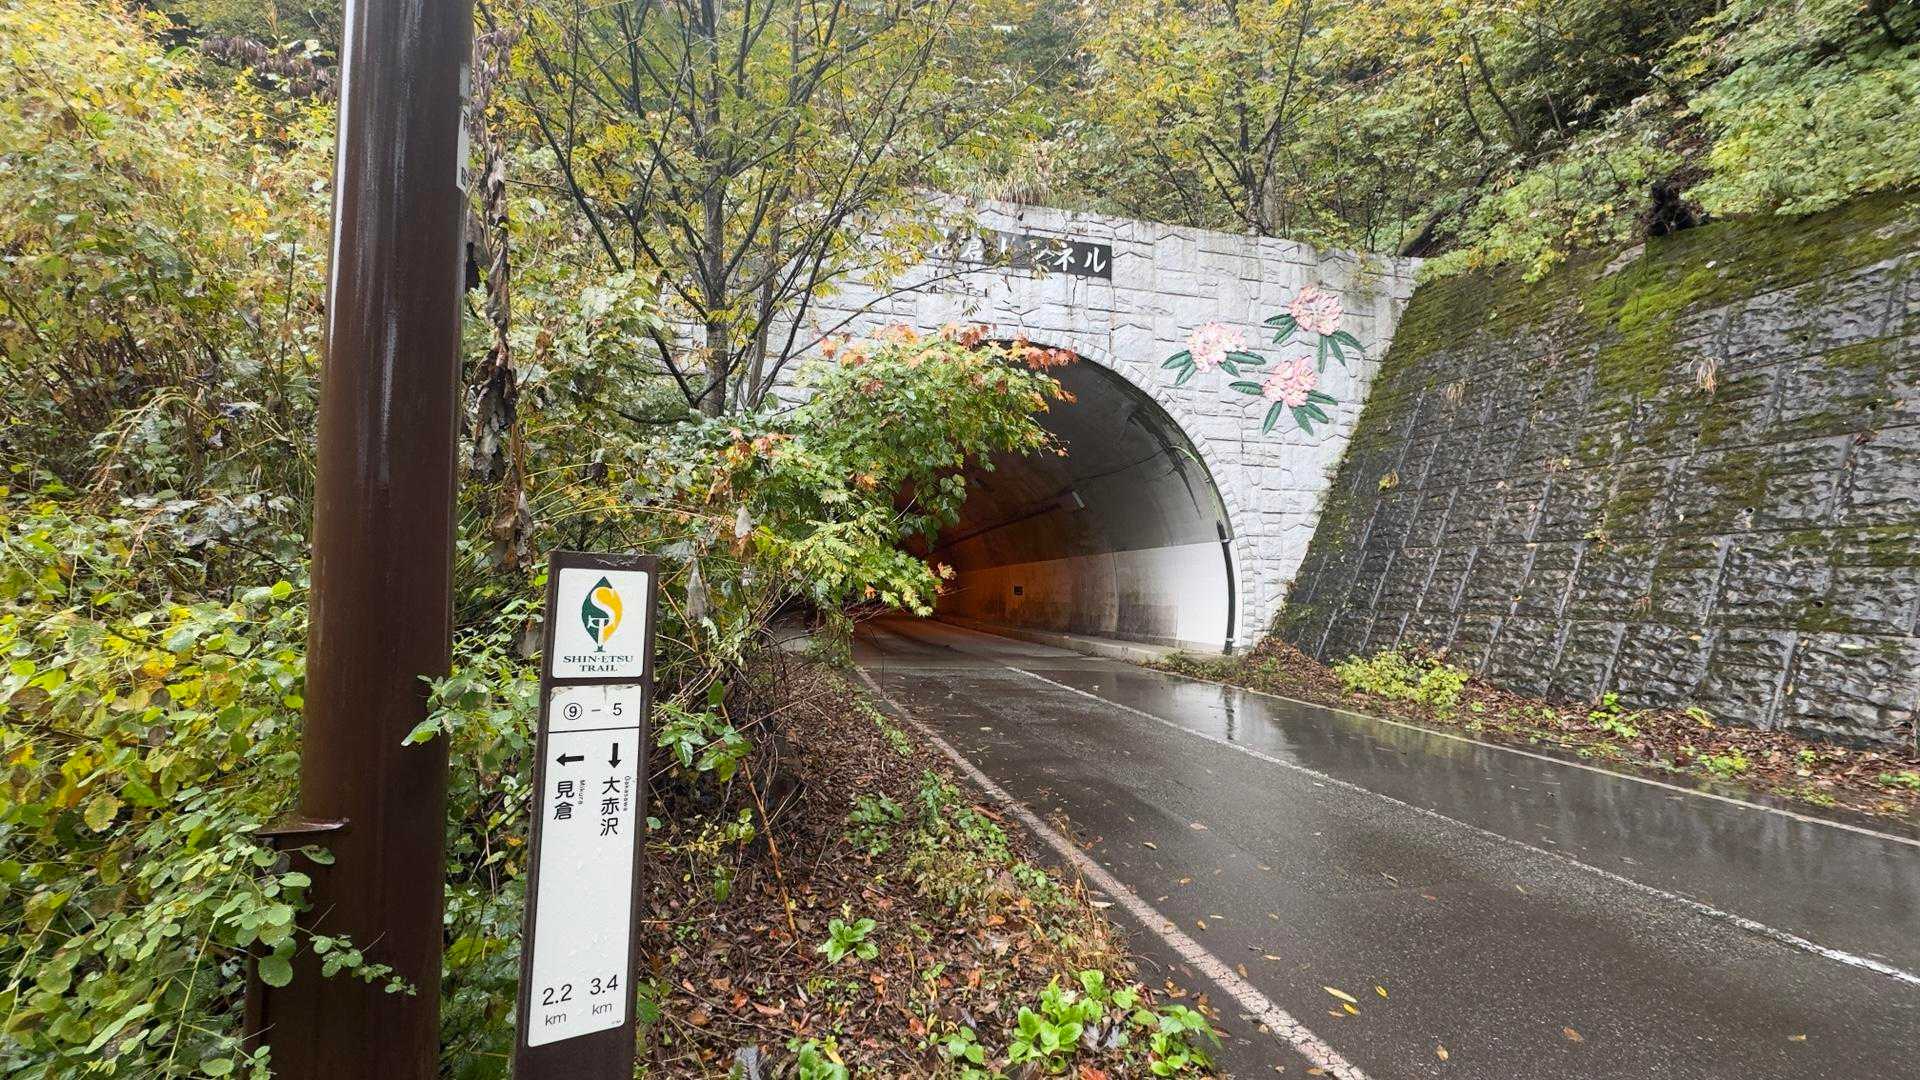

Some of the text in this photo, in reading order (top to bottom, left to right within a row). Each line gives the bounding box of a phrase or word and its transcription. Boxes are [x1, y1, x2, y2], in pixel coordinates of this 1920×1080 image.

[579, 664, 619, 672] TRAIL
[612, 702, 623, 716] 5
[553, 780, 575, 820] 見倉
[600, 776, 621, 836] 大赤沢
[590, 974, 618, 996] 3.4
[542, 984, 573, 1006] 2.2
[592, 1003, 613, 1016] km
[545, 1012, 567, 1026] km
